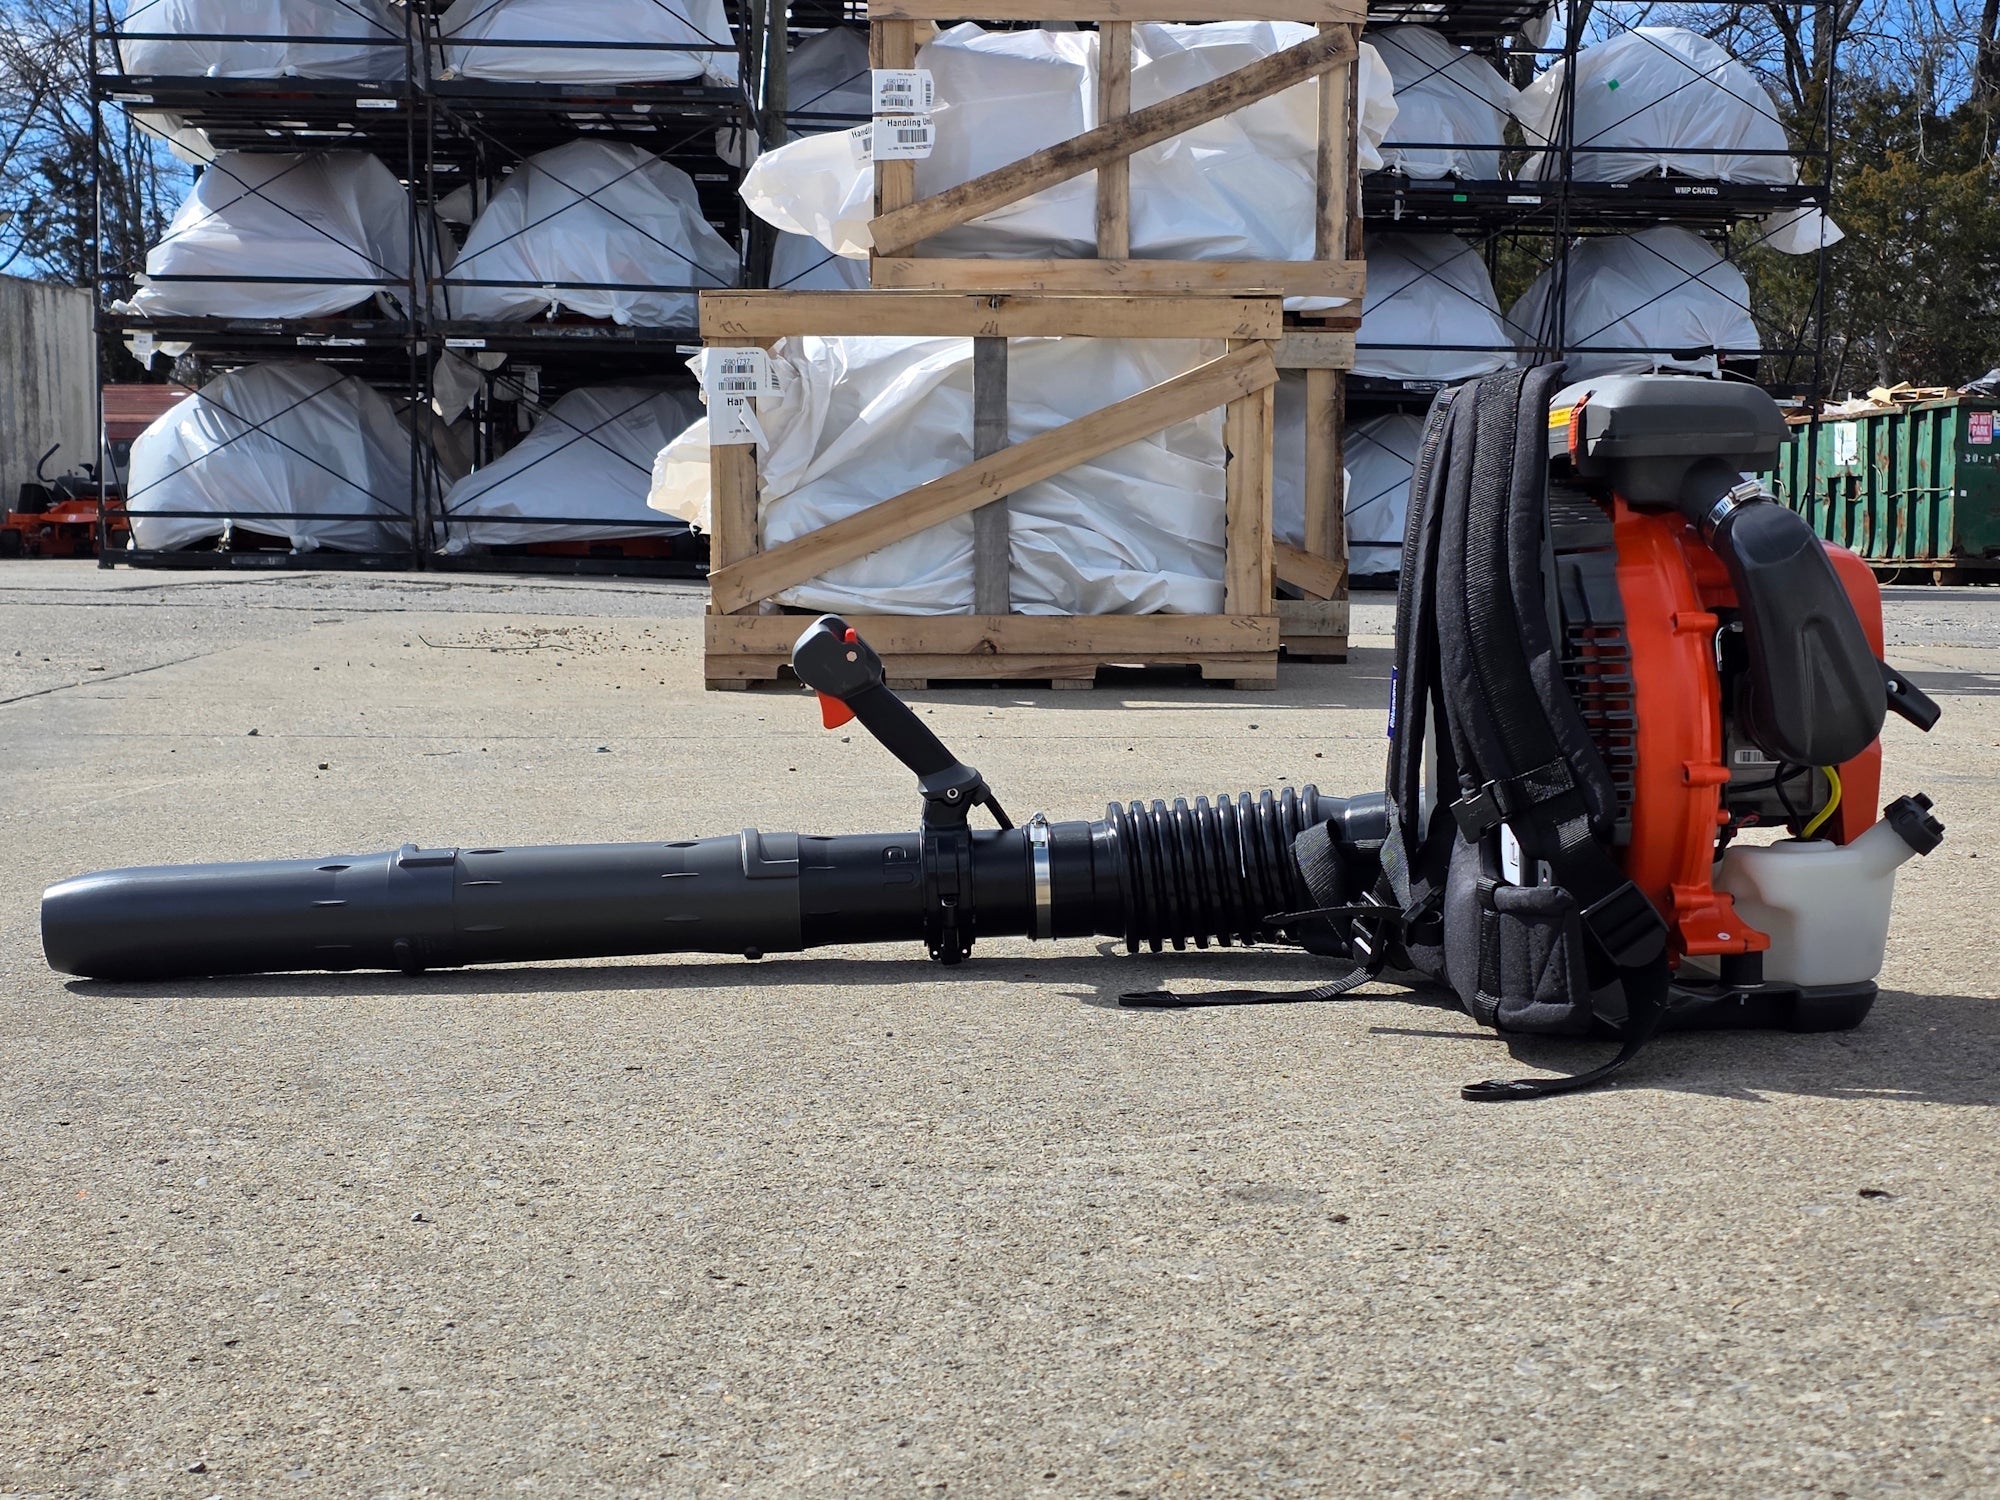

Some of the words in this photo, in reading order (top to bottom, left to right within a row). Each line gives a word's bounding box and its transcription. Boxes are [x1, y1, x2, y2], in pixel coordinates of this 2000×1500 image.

[887, 118, 921, 127] Handling
[1692, 186, 1719, 195] CRATES
[724, 358, 751, 366] 5901737
[1972, 426, 1989, 436] PARK
